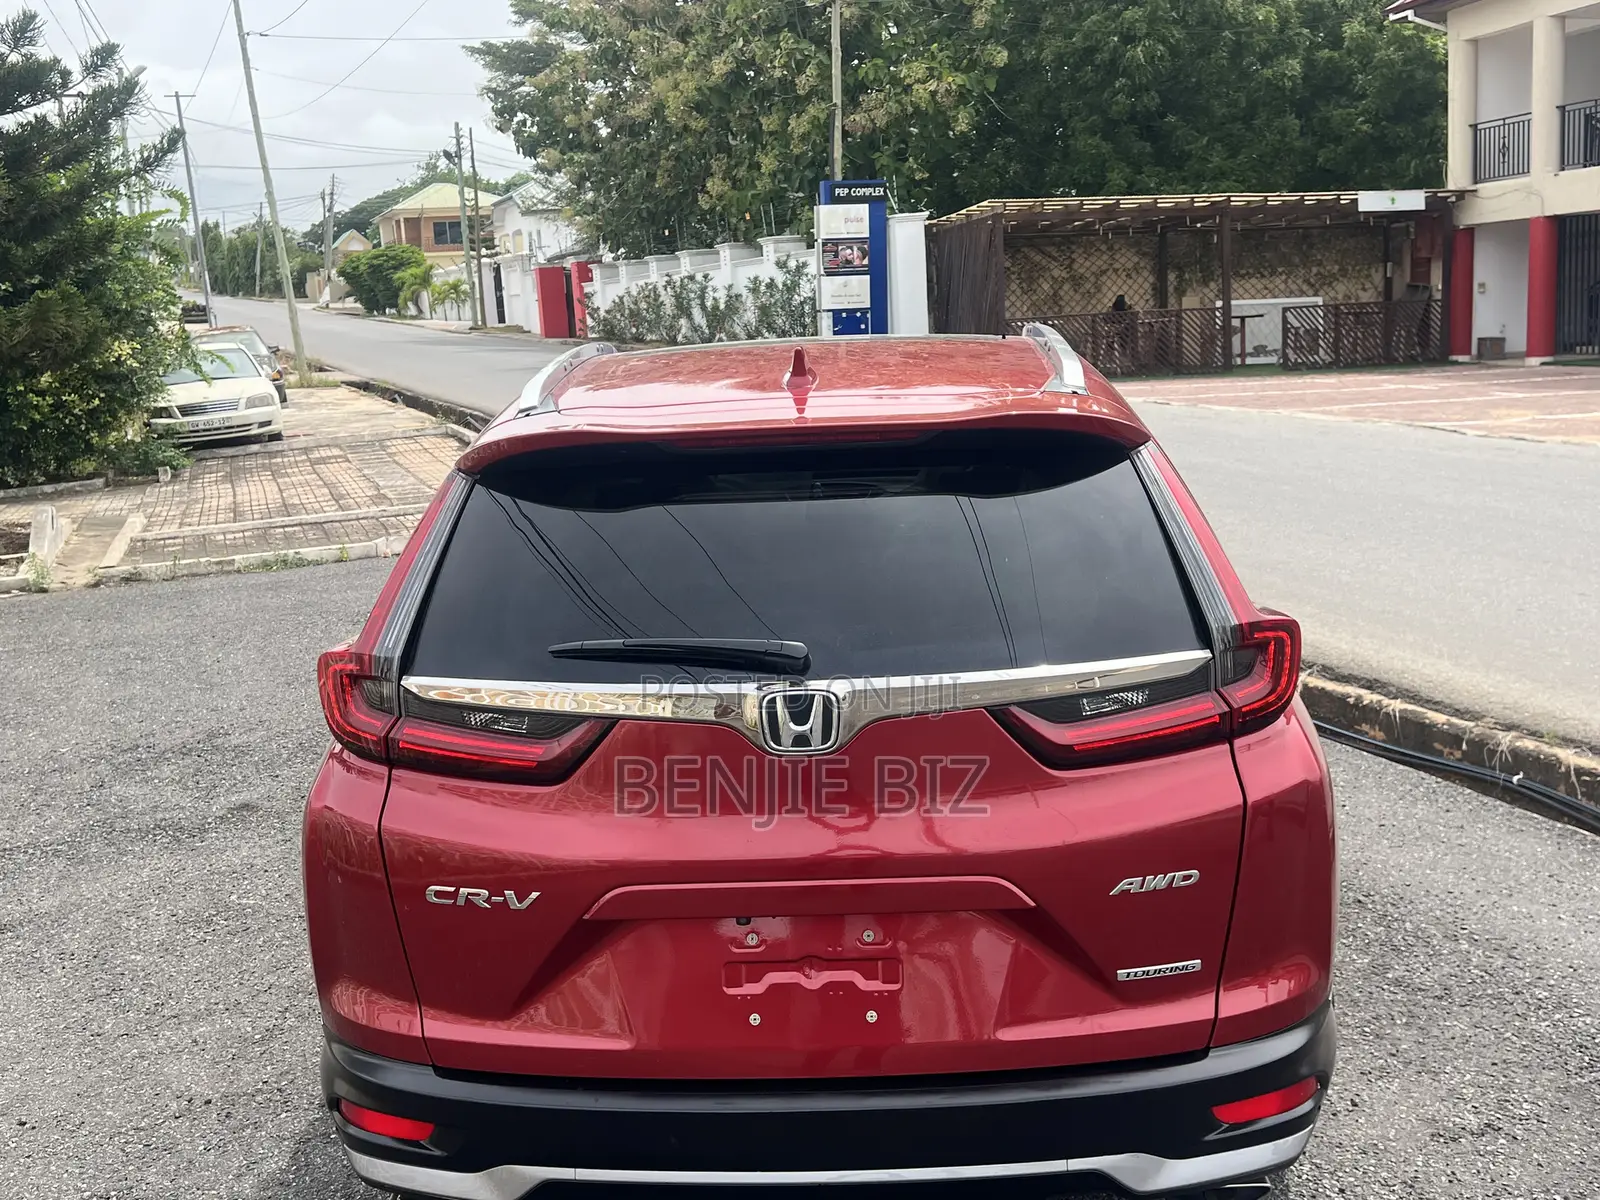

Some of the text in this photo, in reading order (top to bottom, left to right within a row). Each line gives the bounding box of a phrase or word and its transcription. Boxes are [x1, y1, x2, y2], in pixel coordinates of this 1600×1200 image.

[834, 187, 885, 197] PEP COMPLEX
[1109, 869, 1200, 895] AWD
[425, 885, 541, 910] CR-V
[1123, 963, 1197, 979] TOURING
